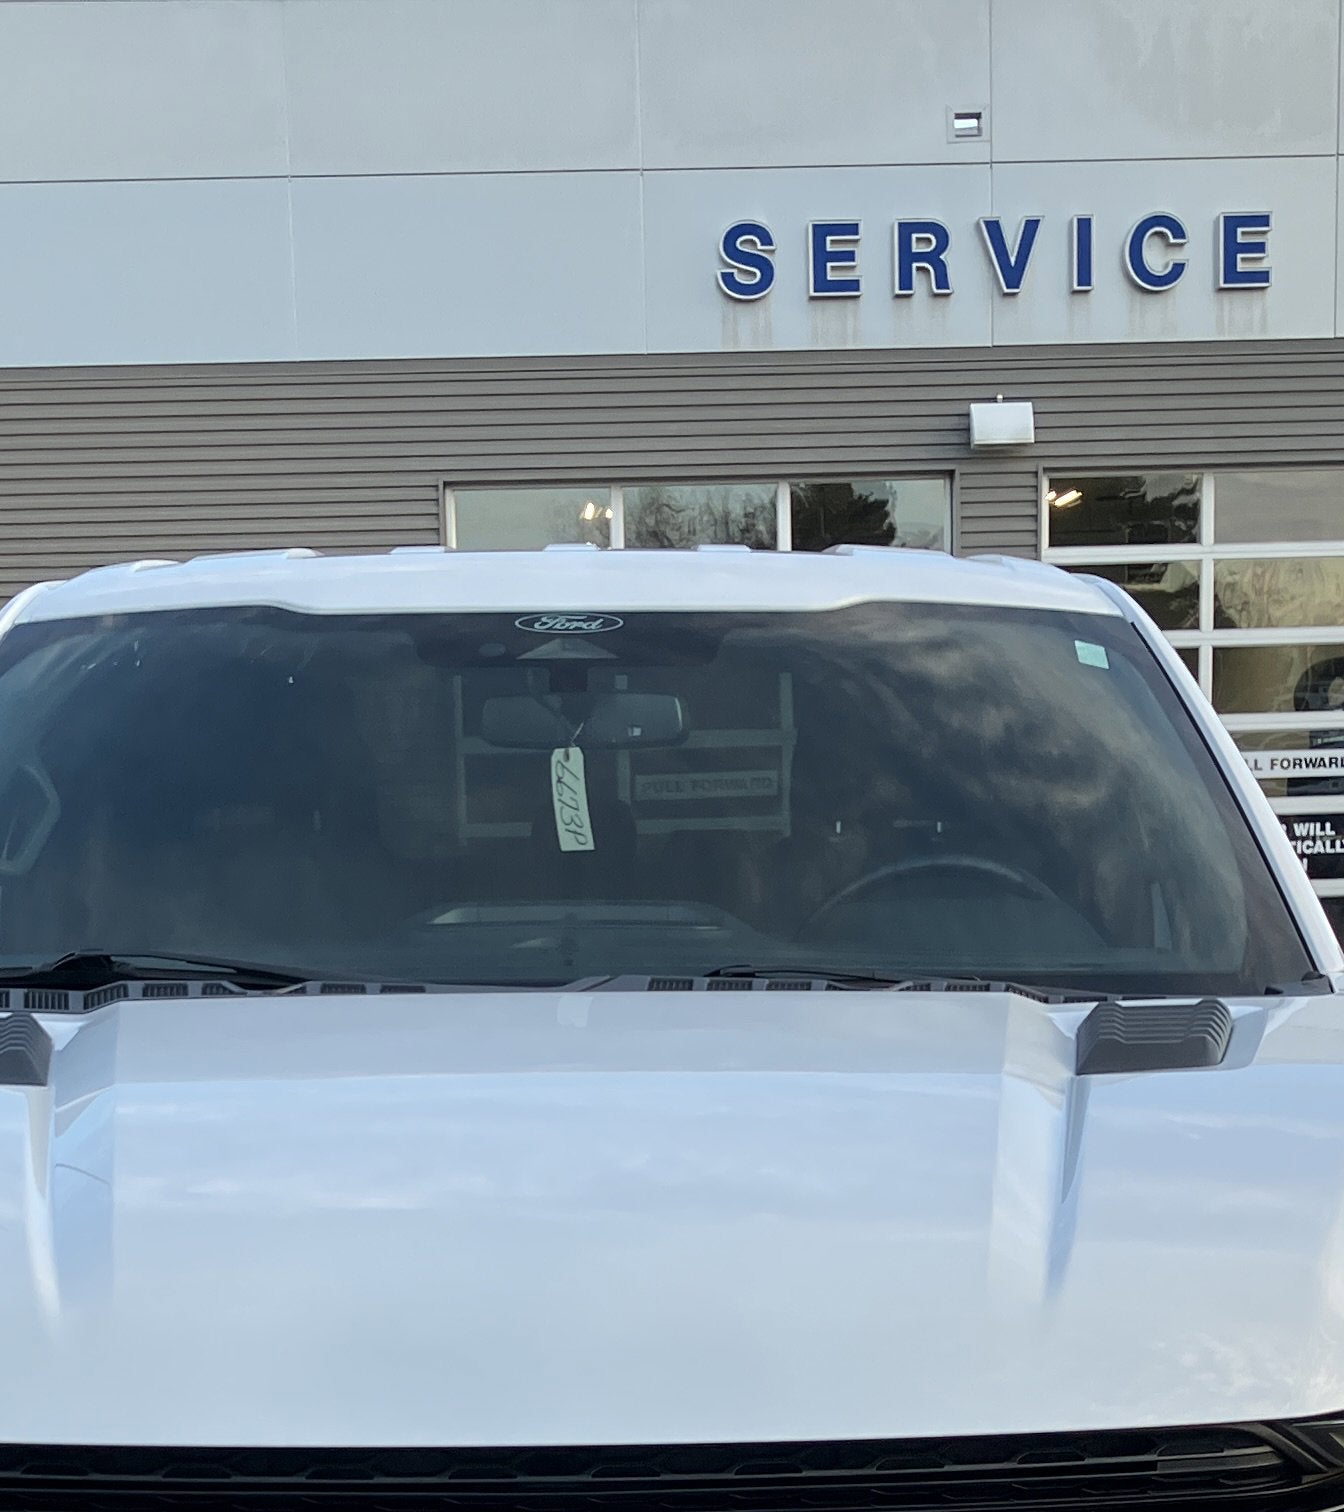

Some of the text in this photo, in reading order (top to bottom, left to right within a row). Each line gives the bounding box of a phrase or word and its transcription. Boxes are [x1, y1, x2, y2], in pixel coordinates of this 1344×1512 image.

[717, 211, 1273, 300] SERVICE
[534, 615, 604, 630] Ford
[1293, 822, 1336, 837] WILL
